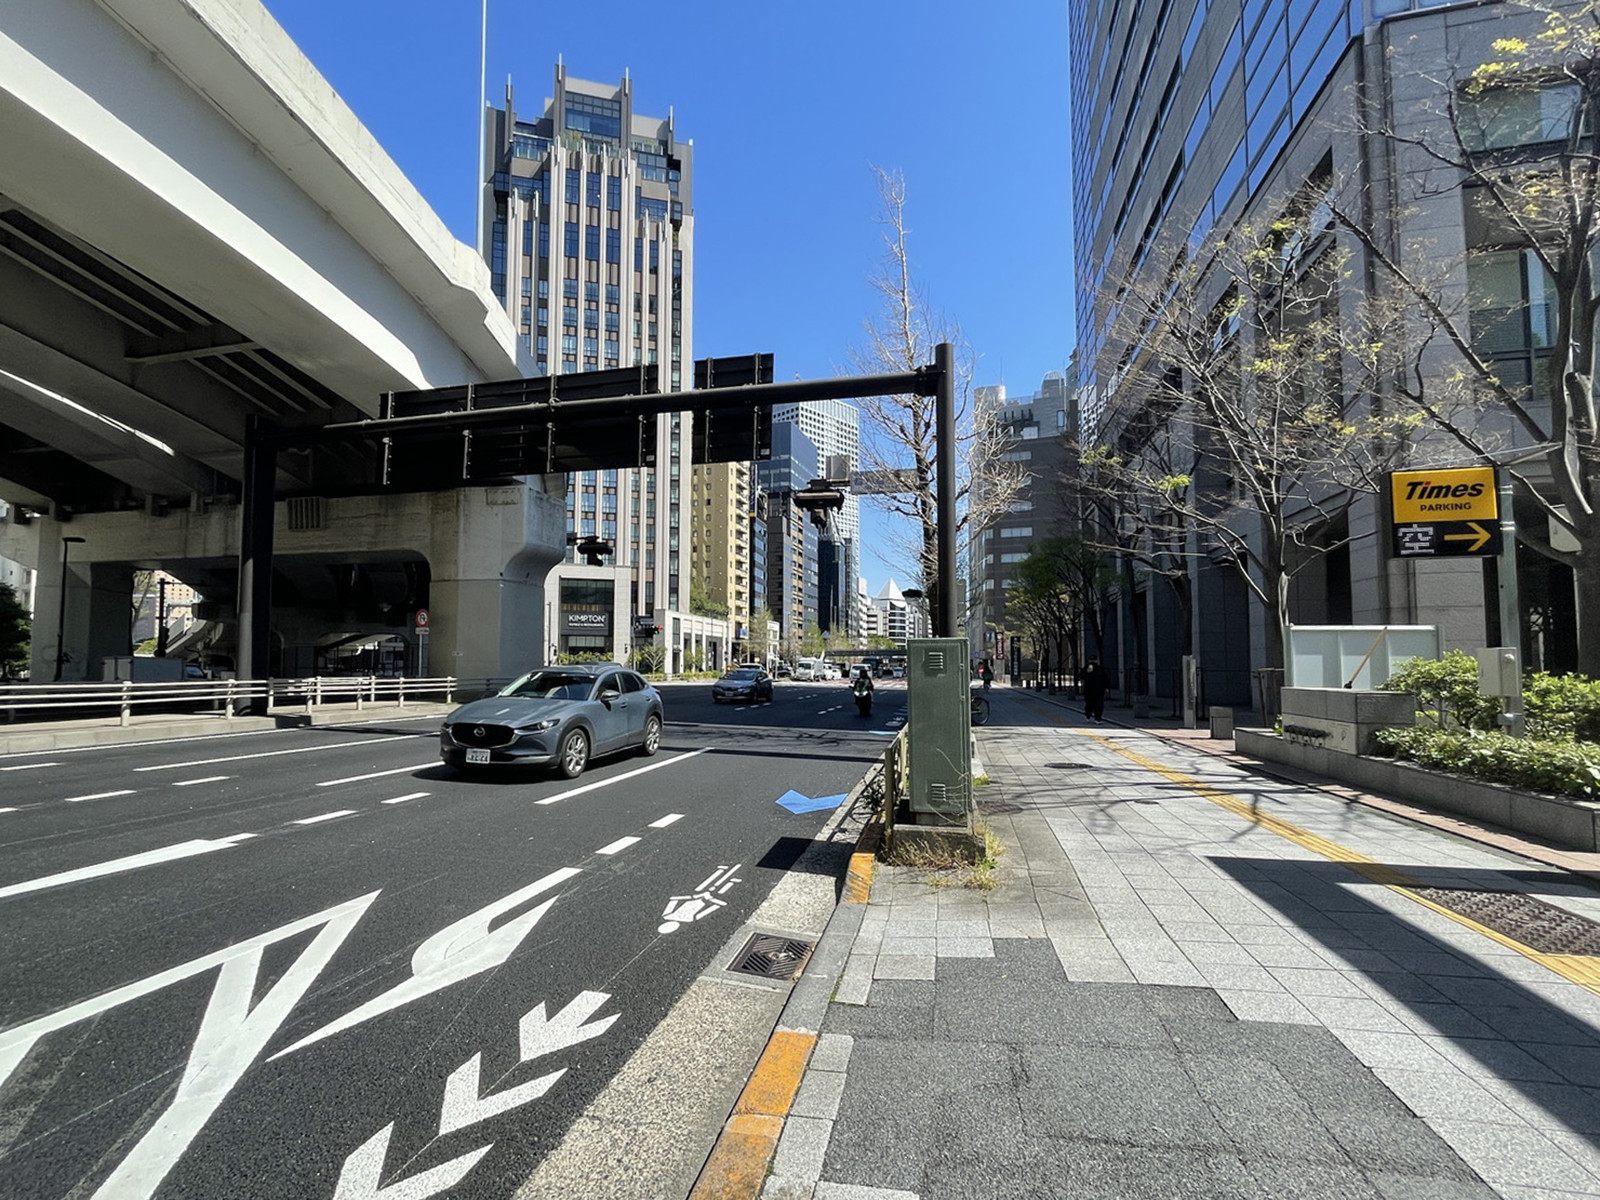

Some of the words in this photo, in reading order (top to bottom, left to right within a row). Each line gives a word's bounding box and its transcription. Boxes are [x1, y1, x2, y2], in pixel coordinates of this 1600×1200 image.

[1405, 481, 1485, 500] Times
[1420, 502, 1472, 512] PARKING
[1397, 523, 1435, 555] 空
[568, 614, 606, 623] KIMPTON
